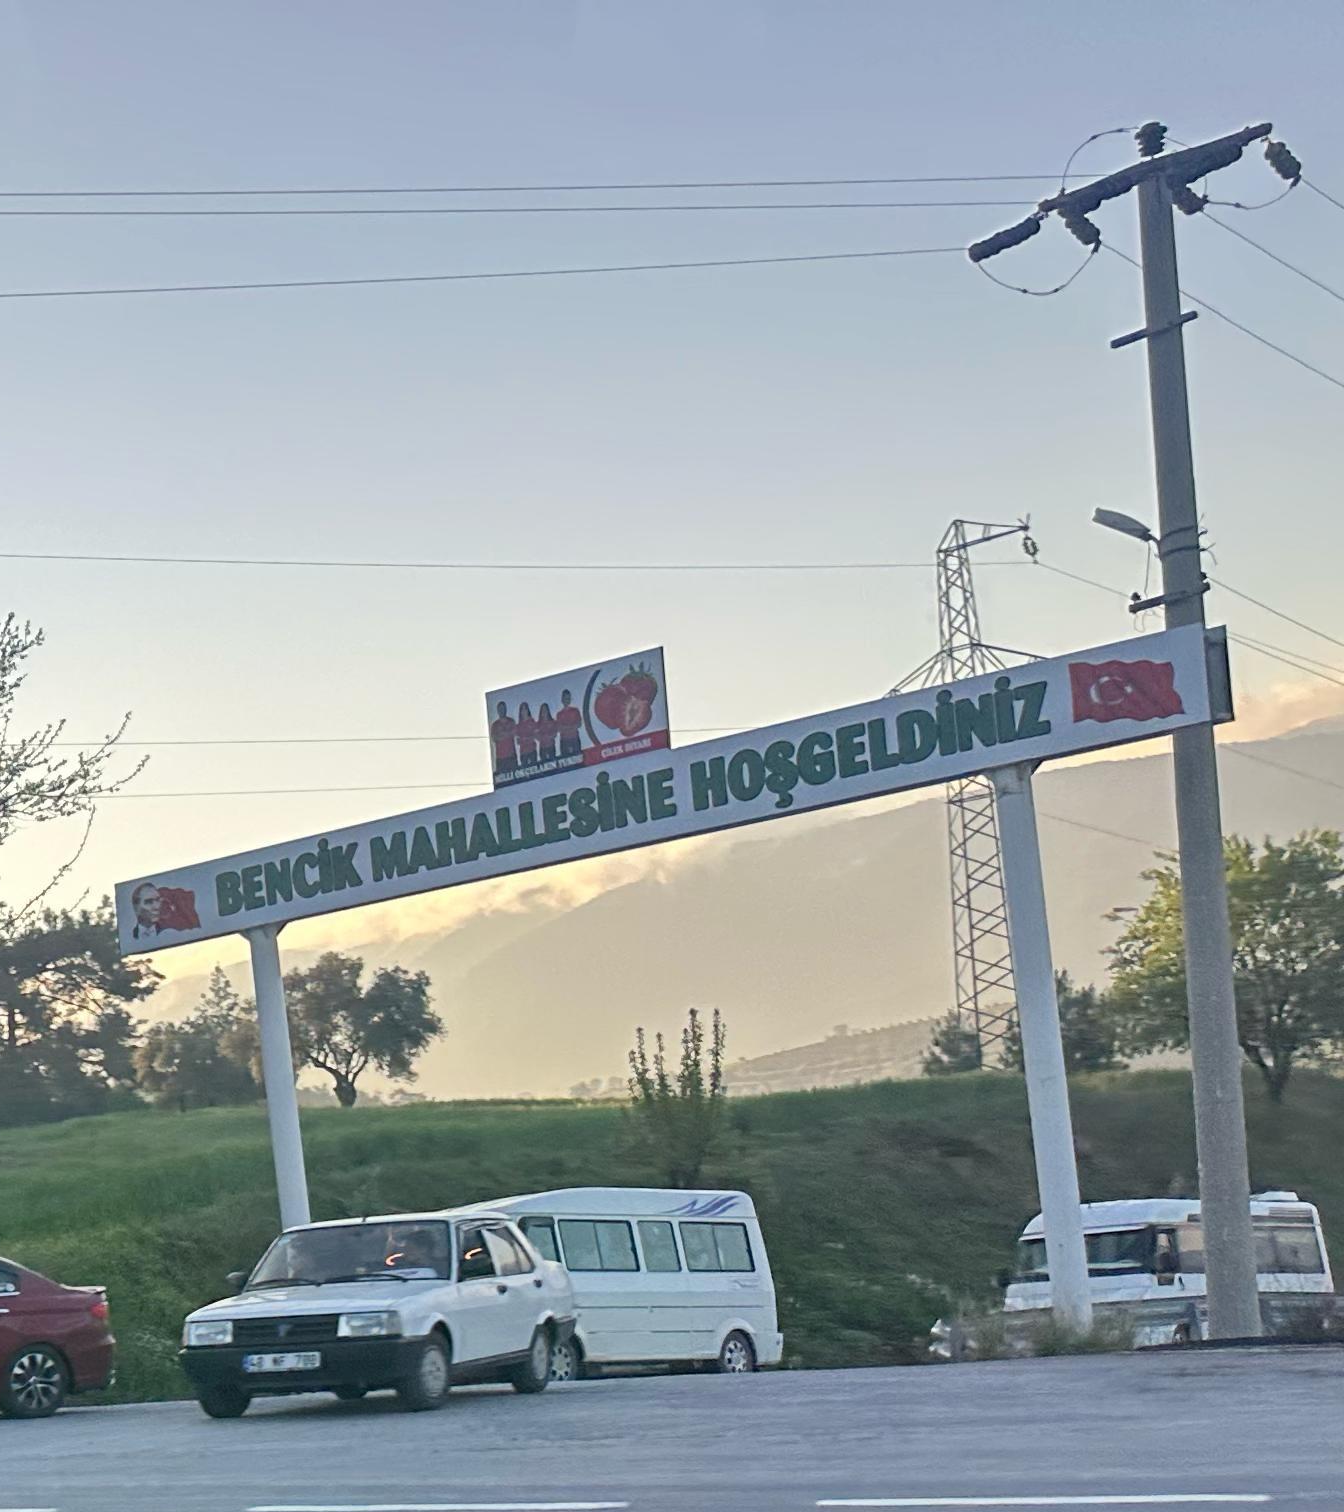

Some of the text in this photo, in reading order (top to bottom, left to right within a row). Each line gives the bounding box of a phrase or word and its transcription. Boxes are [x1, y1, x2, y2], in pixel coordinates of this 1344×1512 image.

[214, 675, 1052, 917] BENCİK MAHALLESİNE HOŞGELDİNİZ
